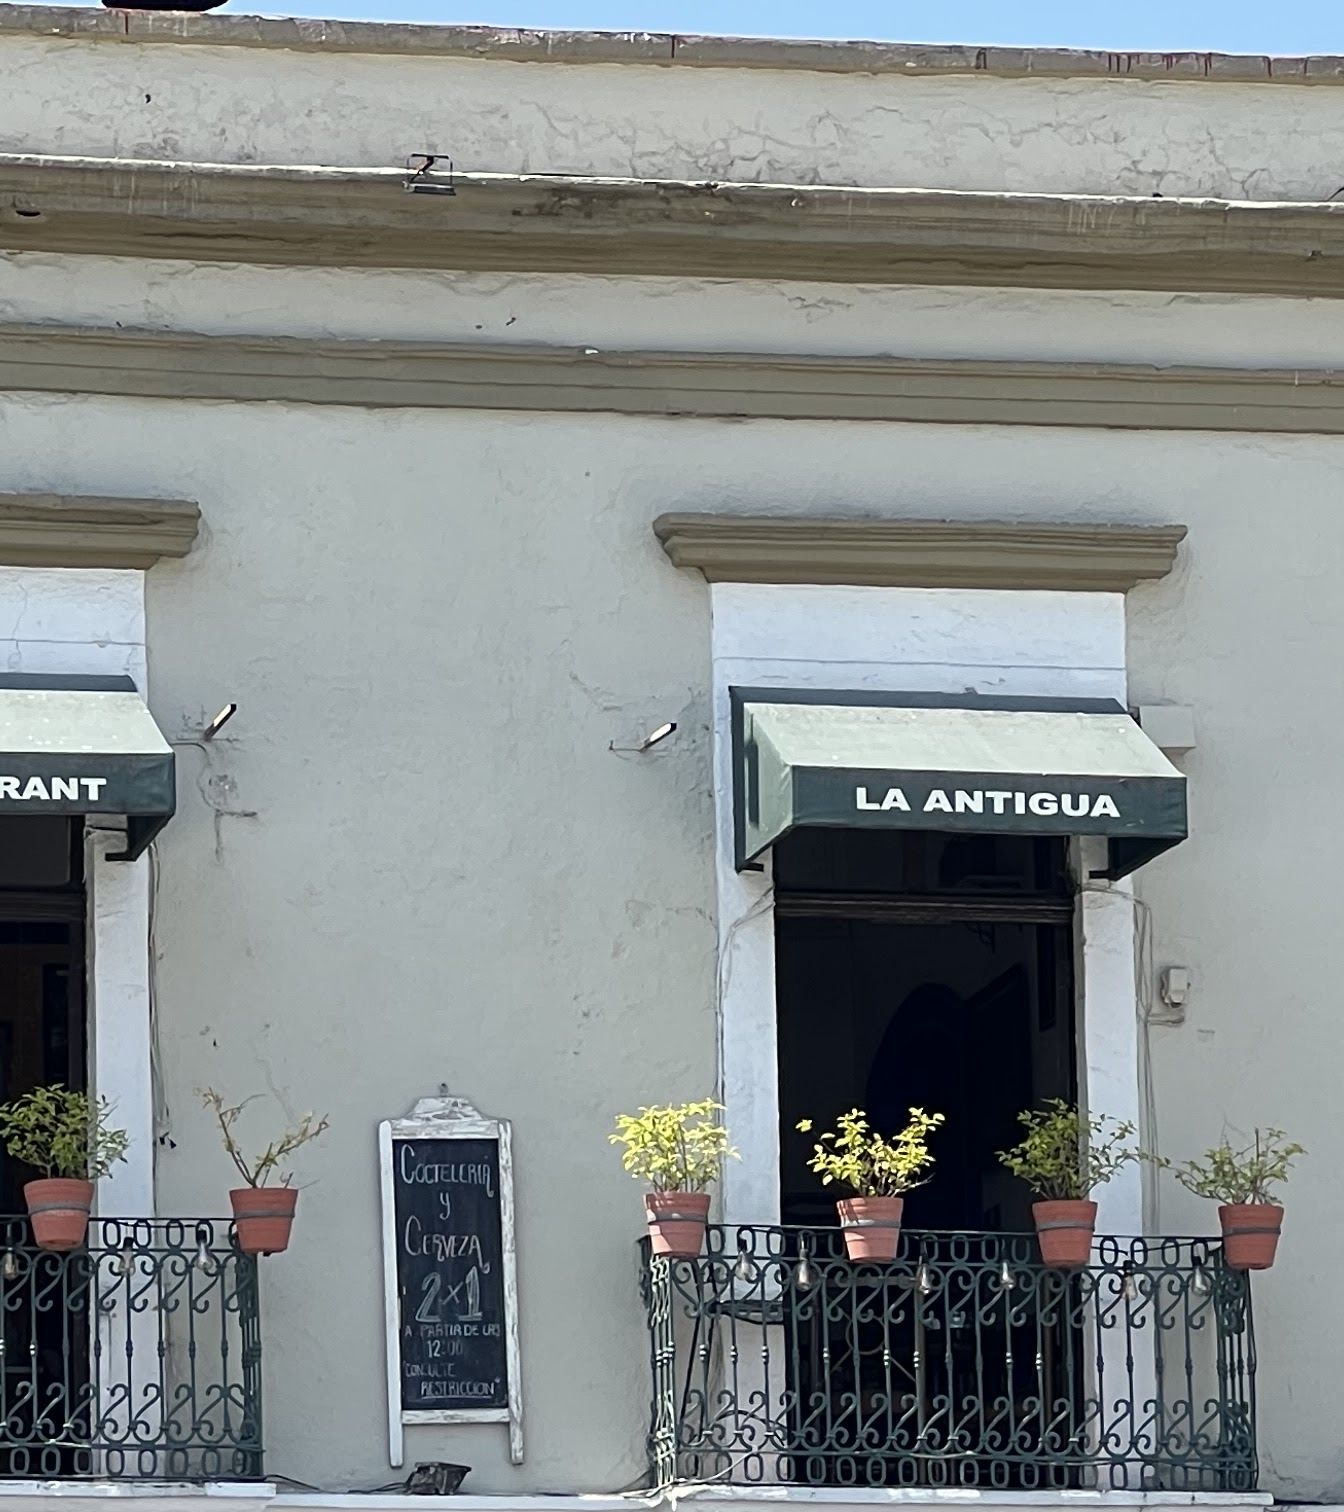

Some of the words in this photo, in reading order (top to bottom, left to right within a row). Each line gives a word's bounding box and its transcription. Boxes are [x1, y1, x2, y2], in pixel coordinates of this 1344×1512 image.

[856, 787, 911, 811] LA
[923, 790, 1121, 818] ANTIGUA
[404, 1325, 413, 1338] A
[420, 1324, 462, 1337] PARTIR
[463, 1324, 479, 1336] DE
